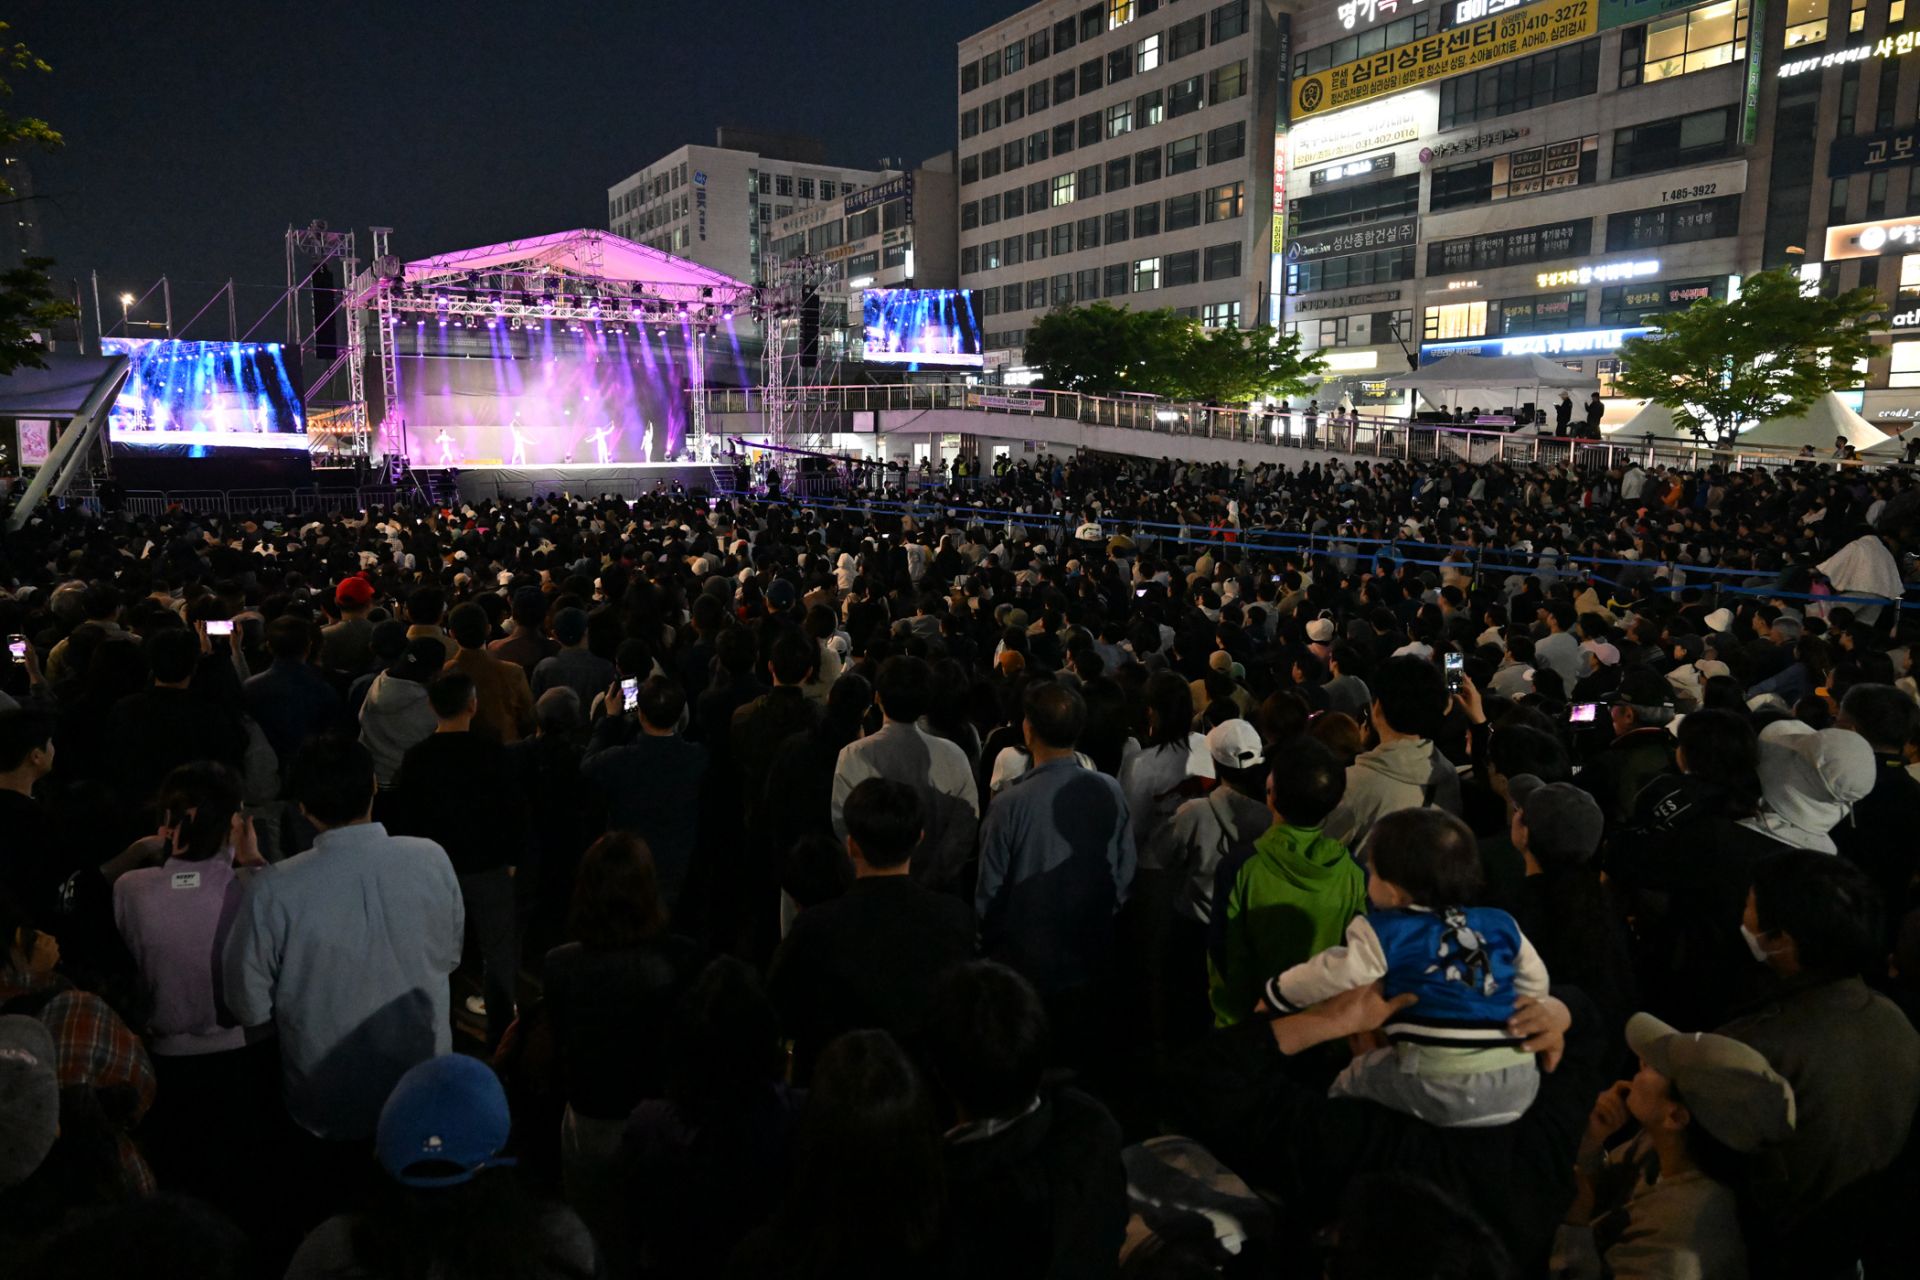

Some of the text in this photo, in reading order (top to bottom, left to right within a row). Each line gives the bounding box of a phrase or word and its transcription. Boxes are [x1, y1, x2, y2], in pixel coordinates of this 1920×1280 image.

[1501, 1, 1587, 39] 031)410-3272
[1351, 21, 1497, 83] 심리상담센터
[1370, 76, 1397, 94] 심리상담
[1403, 69, 1417, 84] 성인
[1418, 67, 1425, 79] 및
[1427, 60, 1449, 77] 청소년
[1551, 19, 1587, 41] 심리검사
[1355, 128, 1415, 150] 031.402.0116
[1864, 135, 1920, 166] 교보
[1671, 183, 1717, 201] 485-3922
